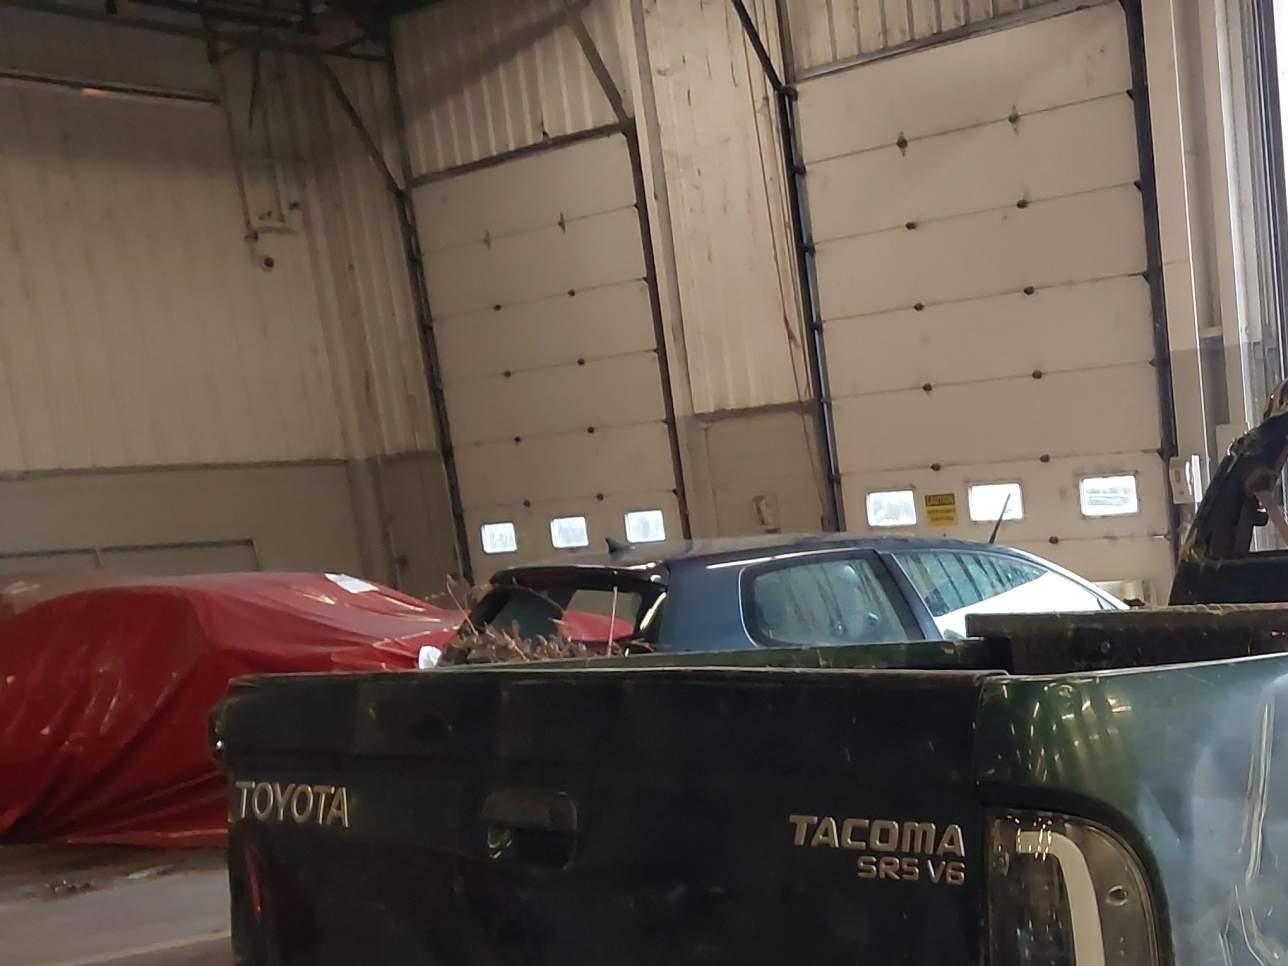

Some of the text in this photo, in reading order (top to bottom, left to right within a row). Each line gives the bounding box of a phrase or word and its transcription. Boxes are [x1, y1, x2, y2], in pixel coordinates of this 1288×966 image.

[235, 781, 349, 828] TOYOTA
[789, 815, 965, 857] TACOMA
[857, 855, 965, 885] SRS V6
